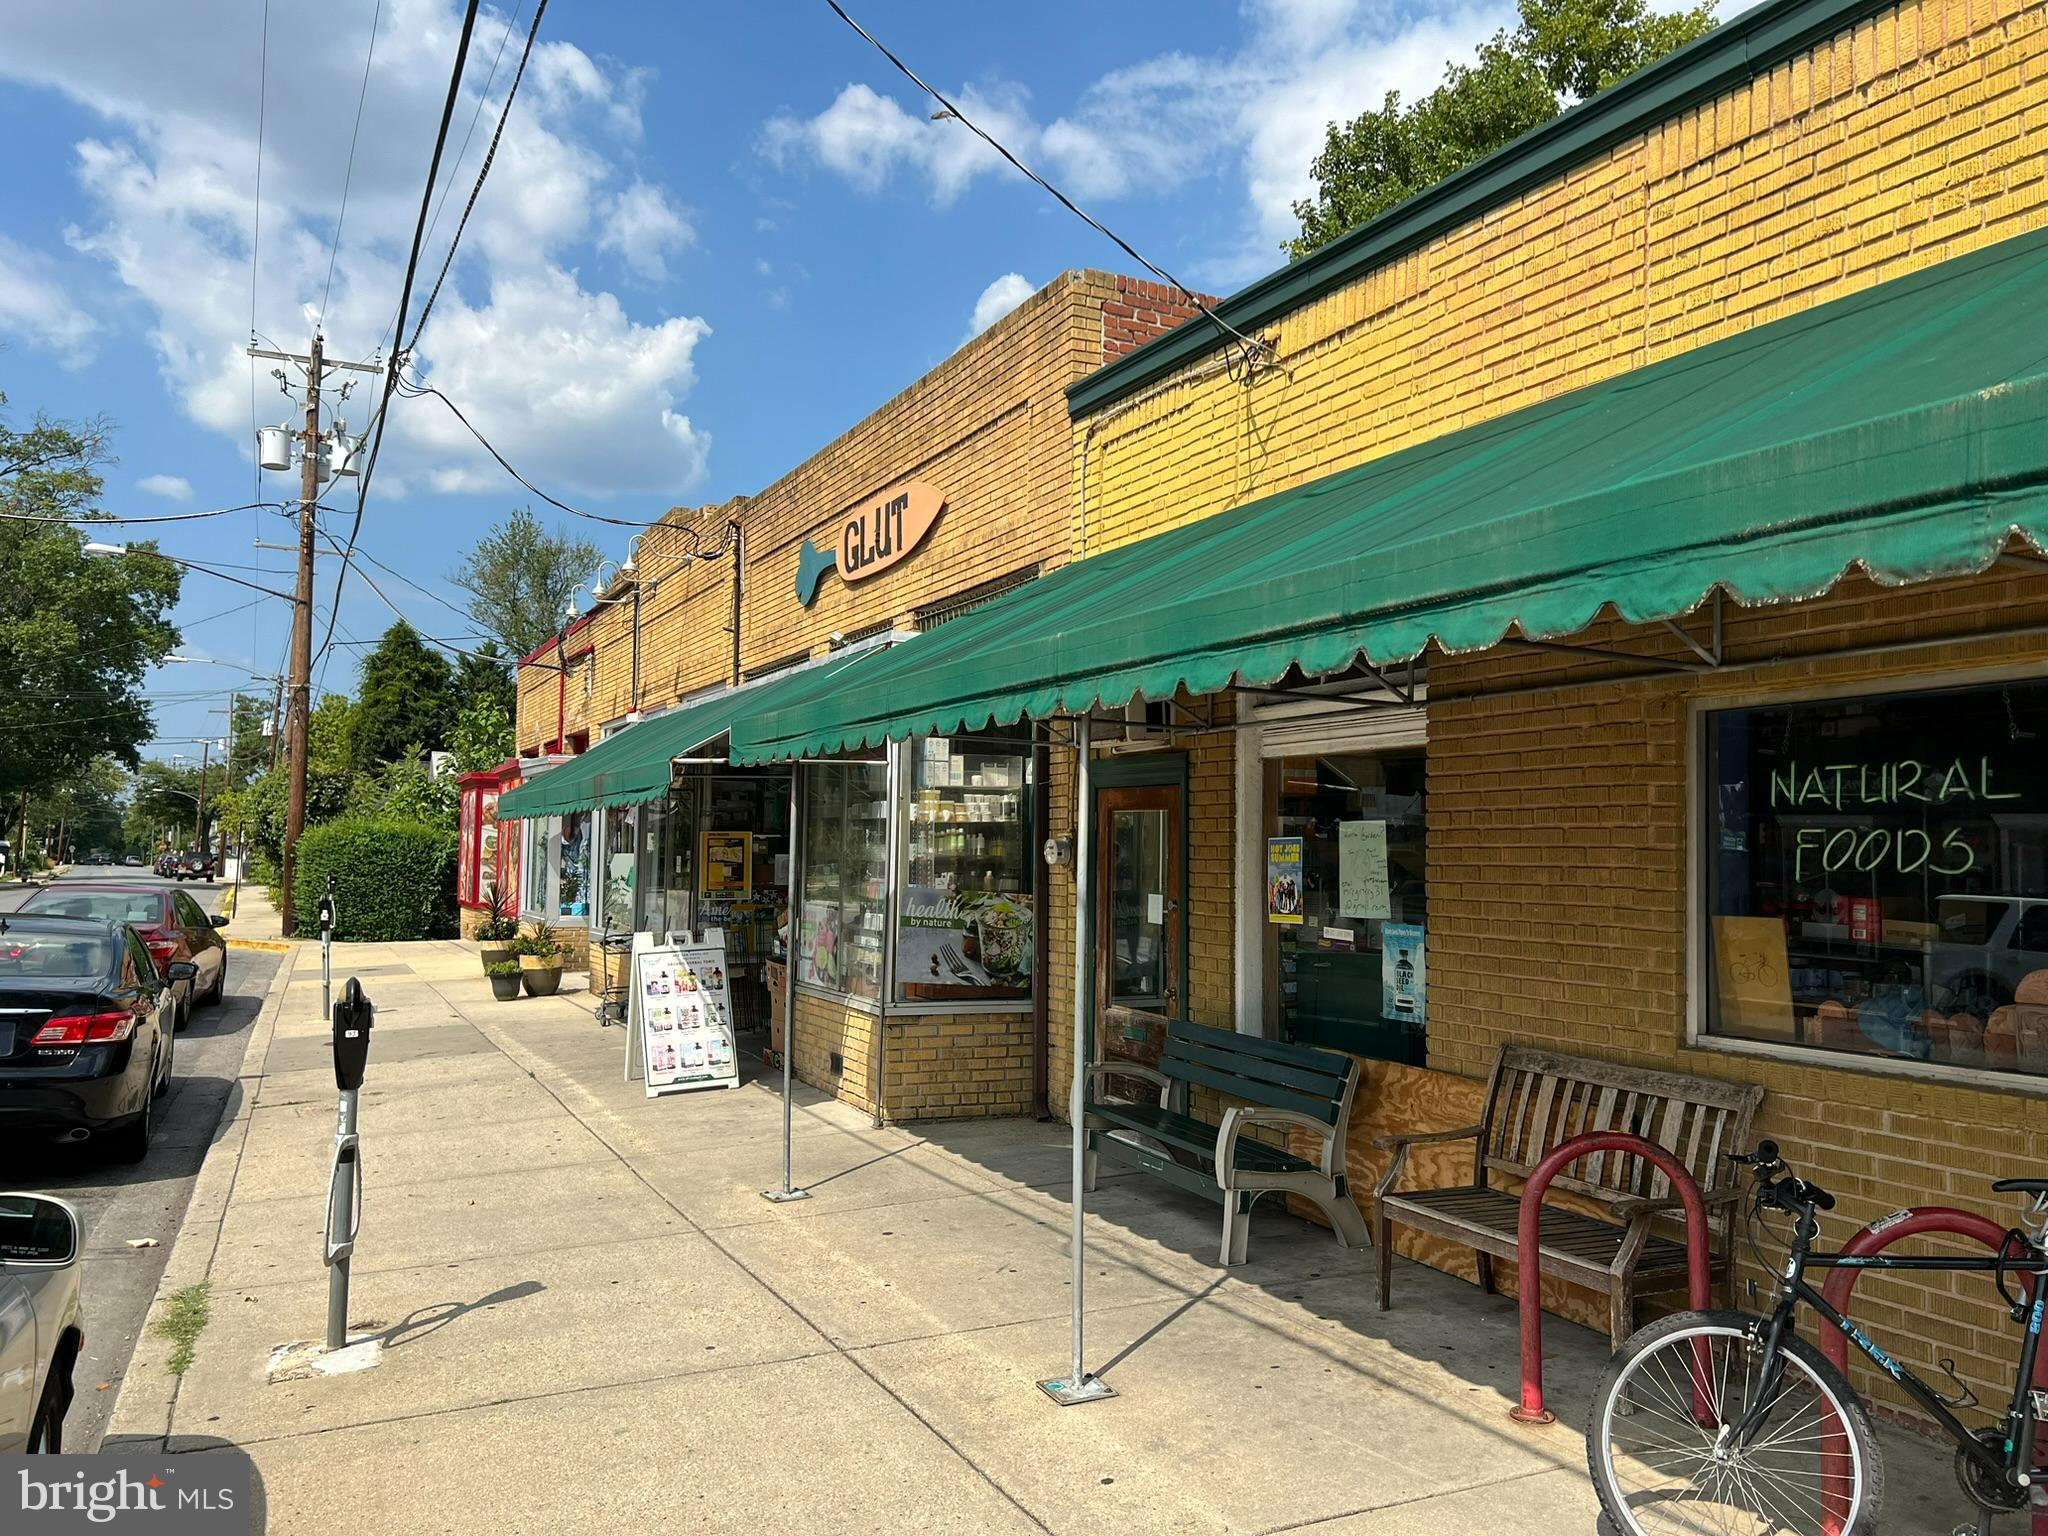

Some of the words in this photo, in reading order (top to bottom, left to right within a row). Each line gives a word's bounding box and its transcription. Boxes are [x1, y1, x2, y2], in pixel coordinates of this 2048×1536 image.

[844, 492, 908, 574] GLUT
[1771, 755, 2022, 812] NATURAL
[1270, 853, 1300, 863] SUMMER
[1795, 827, 1975, 883] FOODS
[905, 894, 964, 920] health
[910, 918, 920, 927] by
[923, 919, 953, 927] nature
[1396, 970, 1414, 979] BLACK
[1838, 1313, 1902, 1380] TREK
